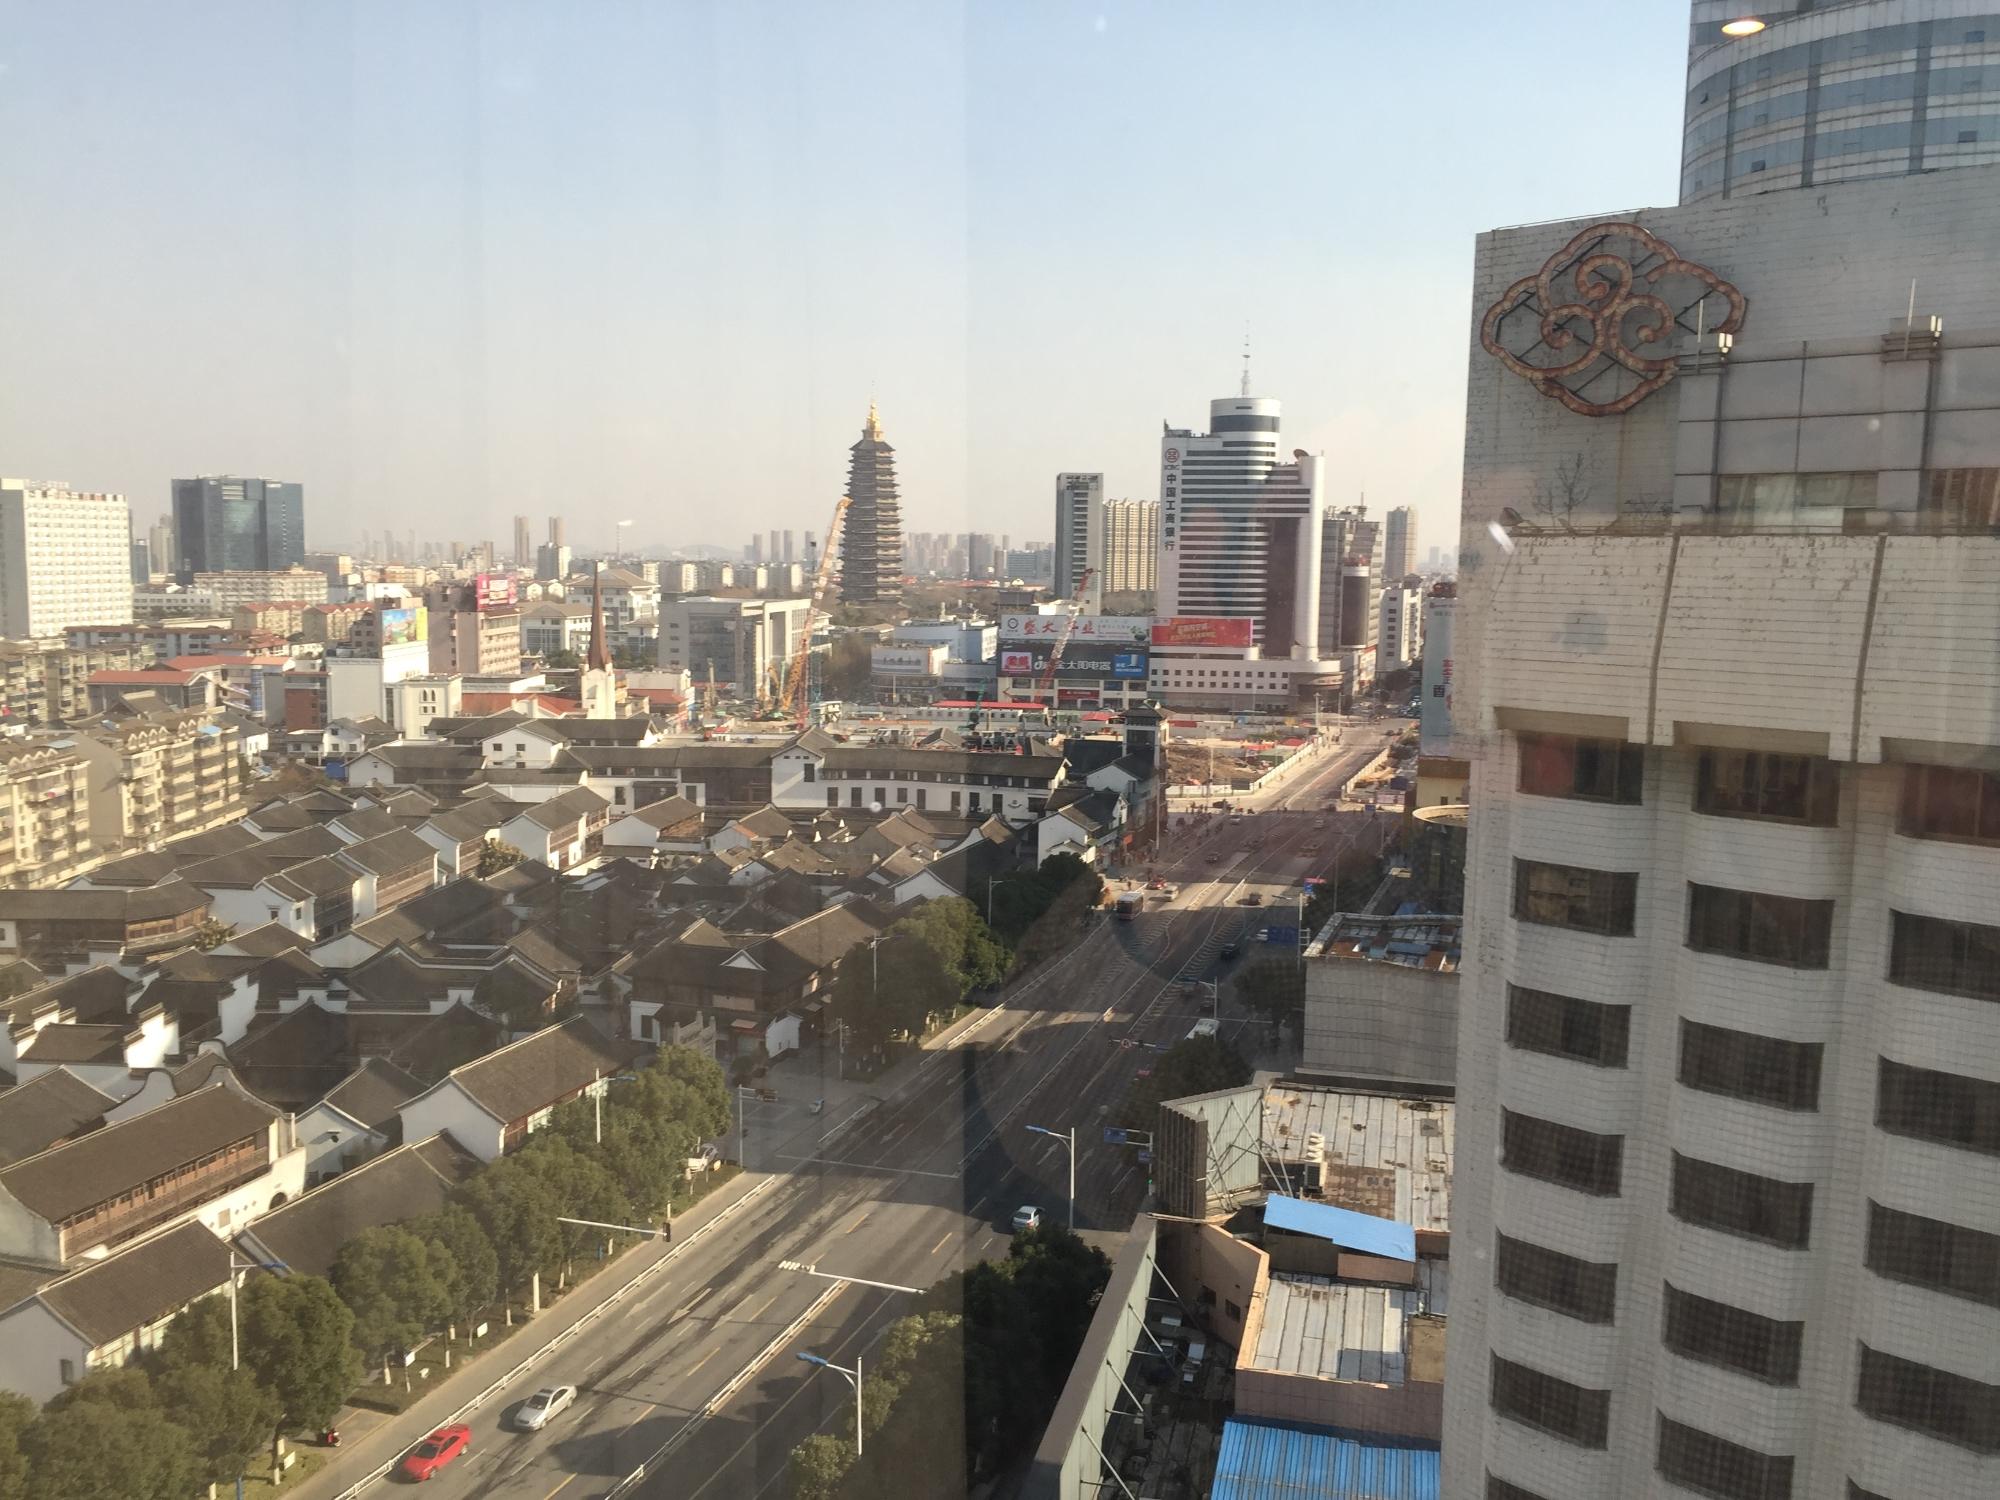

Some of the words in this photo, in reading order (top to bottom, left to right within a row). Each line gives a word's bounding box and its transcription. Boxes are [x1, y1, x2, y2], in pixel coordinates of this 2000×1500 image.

[1165, 473, 1177, 551] 中国工商银行
